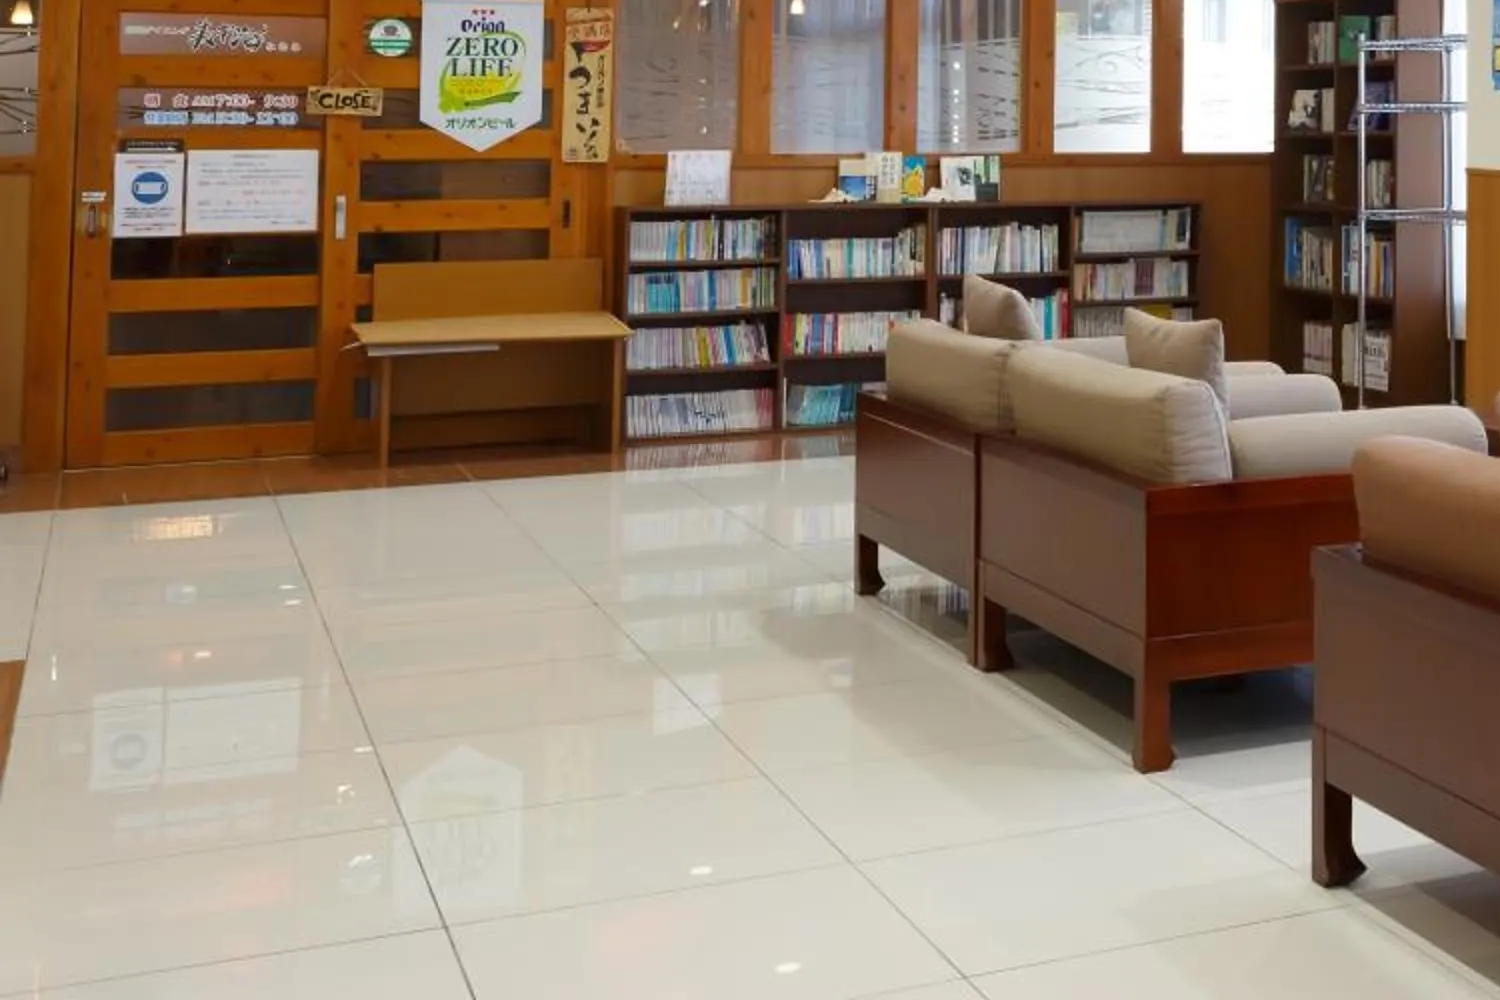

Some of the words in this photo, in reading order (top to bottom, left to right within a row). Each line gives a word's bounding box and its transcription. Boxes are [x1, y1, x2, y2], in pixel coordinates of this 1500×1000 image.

[446, 36, 519, 57] ZERO
[451, 57, 513, 77] LIFE
[318, 91, 372, 109] CLOSE
[444, 117, 516, 129] オリオンビール
